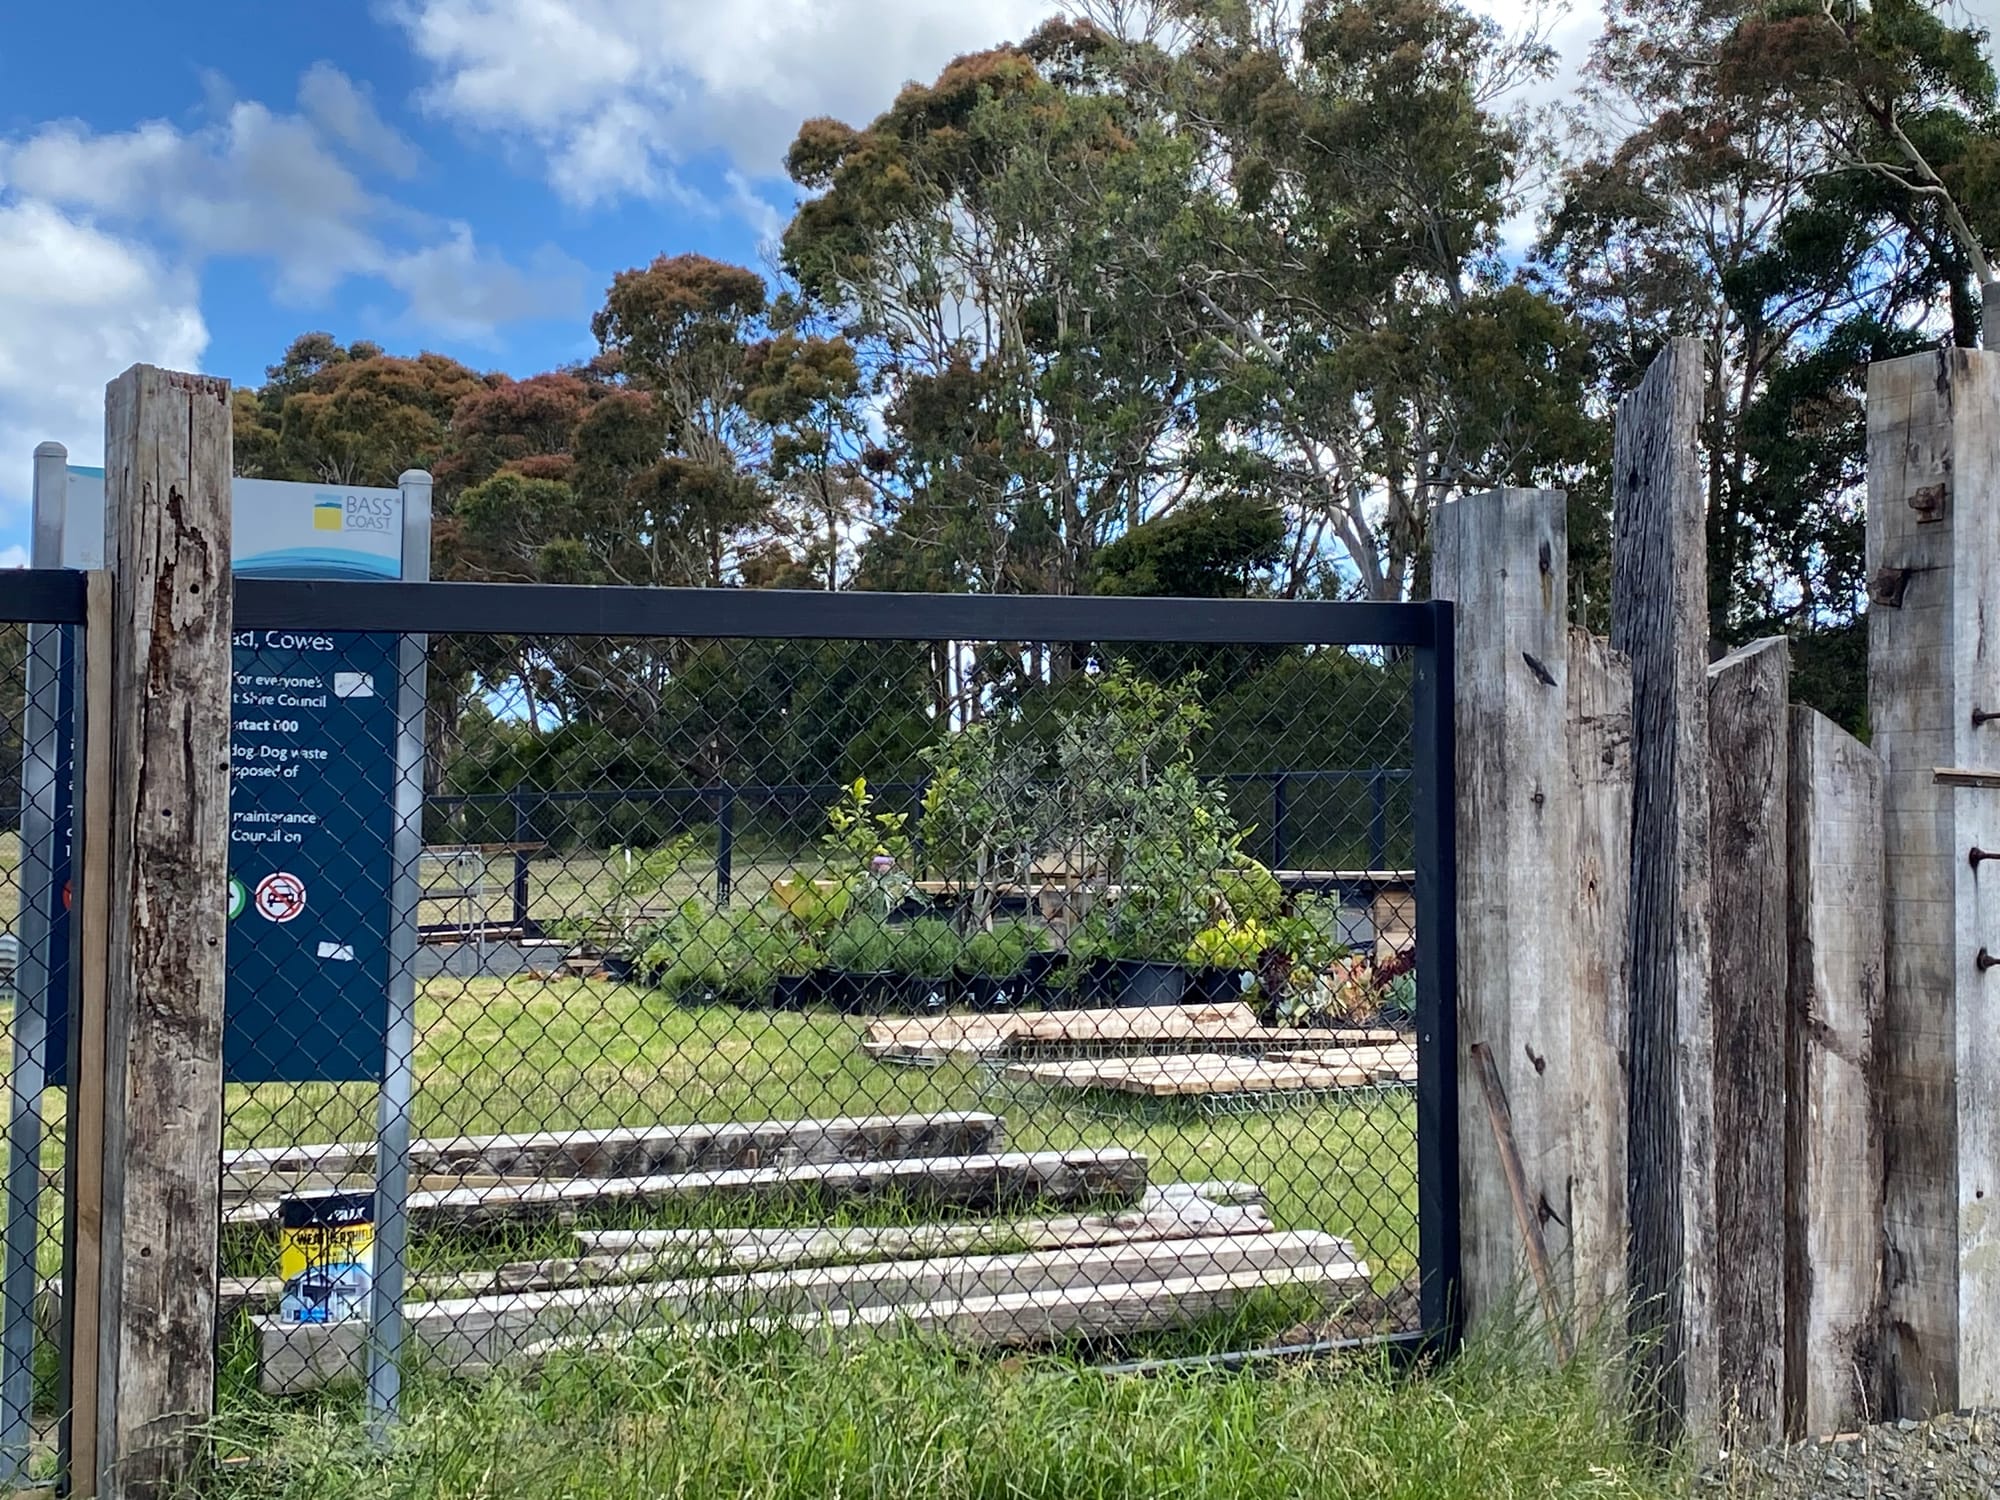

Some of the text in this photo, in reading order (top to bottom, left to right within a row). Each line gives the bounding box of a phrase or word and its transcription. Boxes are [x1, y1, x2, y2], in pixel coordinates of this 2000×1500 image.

[346, 495, 392, 516] BASS
[346, 515, 391, 529] COAST
[265, 630, 334, 651] Cowes
[255, 675, 323, 690] everyone's
[242, 691, 274, 705] Shire
[278, 694, 327, 708] Council
[260, 745, 288, 762] Dog
[290, 748, 329, 760] waste
[283, 765, 299, 778] of
[233, 811, 317, 824] maintenance
[231, 829, 302, 842] Council on
